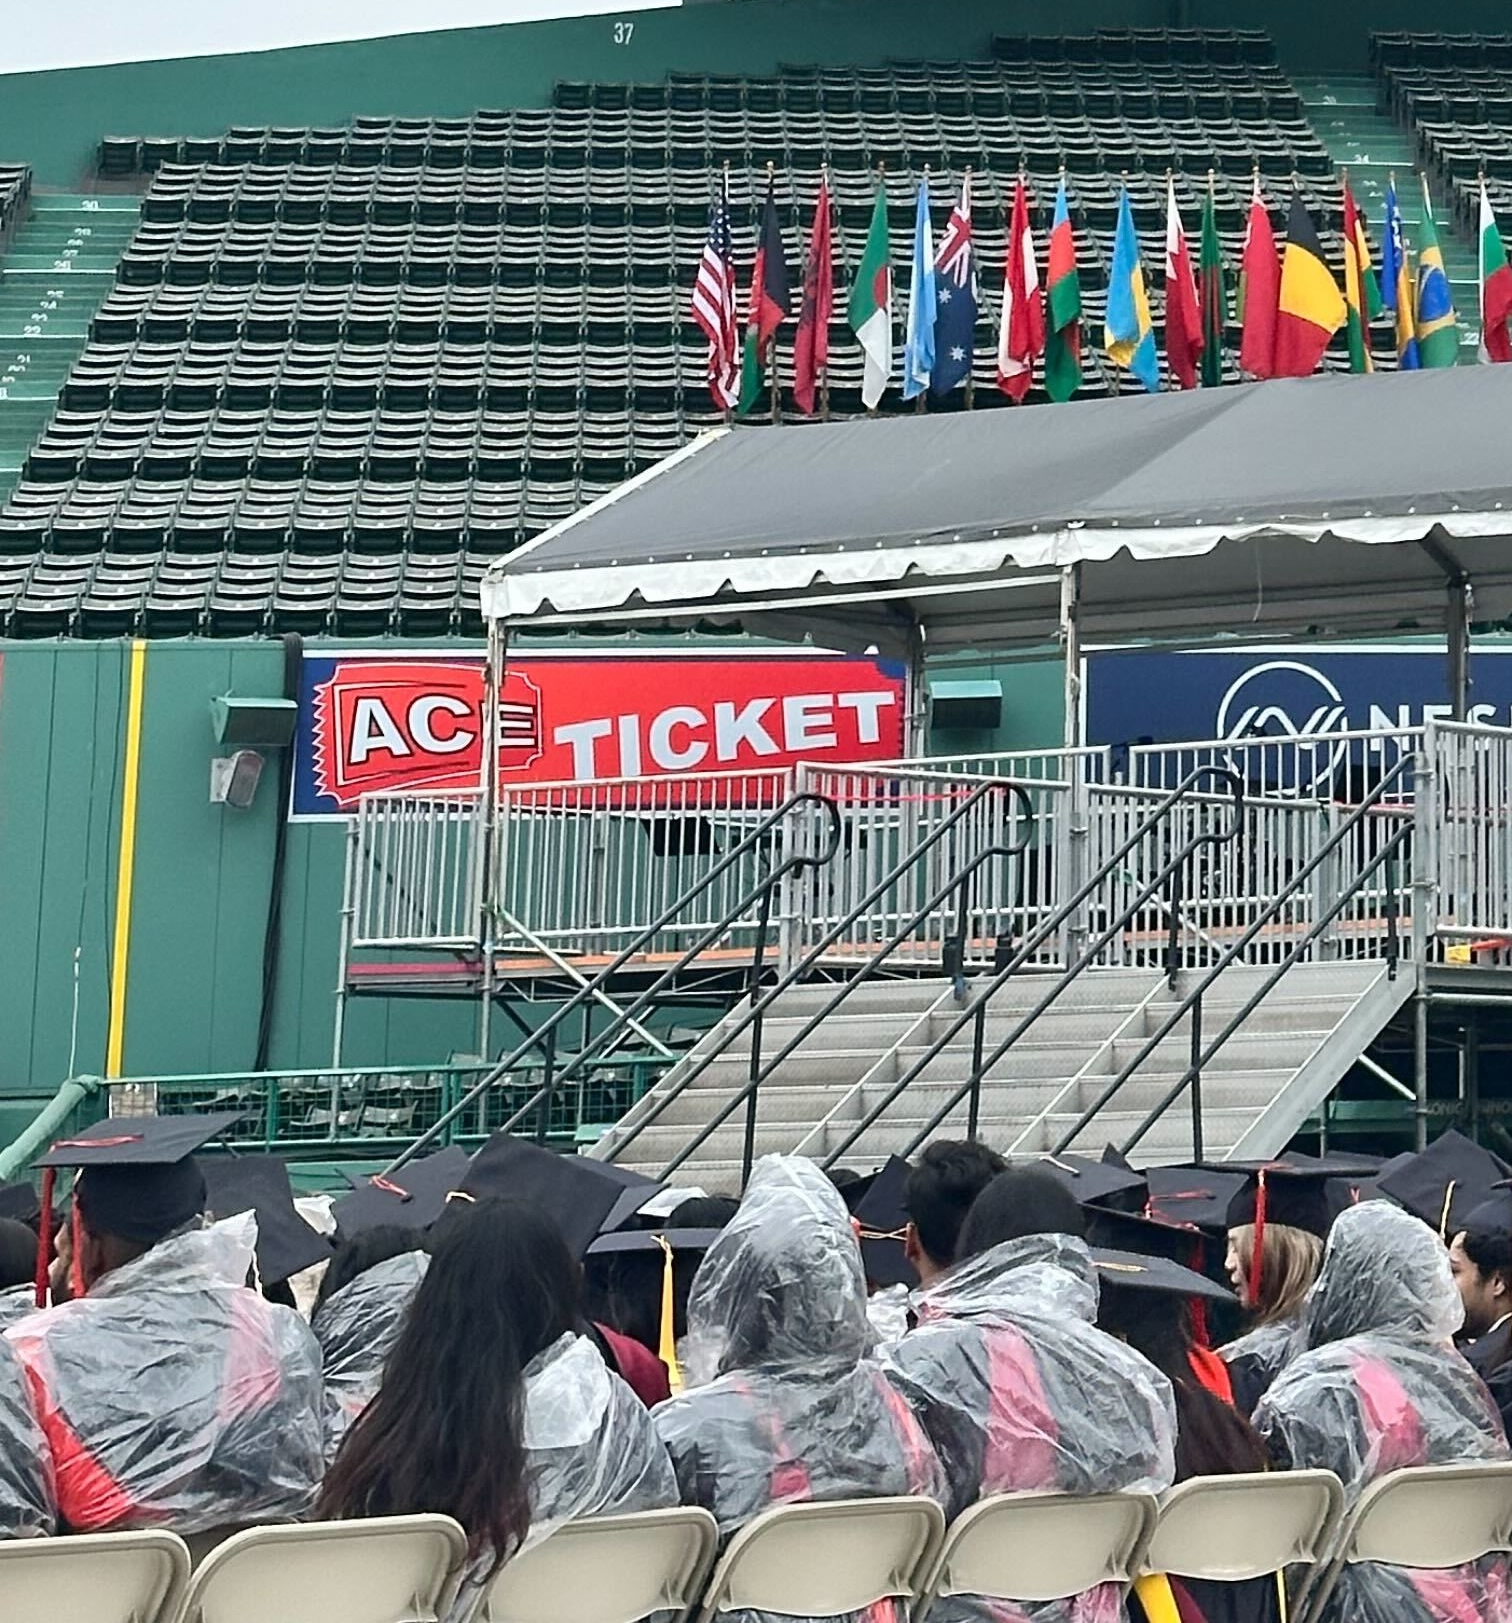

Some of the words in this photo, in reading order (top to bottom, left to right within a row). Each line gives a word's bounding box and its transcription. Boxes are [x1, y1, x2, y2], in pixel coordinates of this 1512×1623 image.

[613, 22, 634, 46] 37
[348, 693, 536, 764] ACE
[554, 691, 896, 778] TICKET
